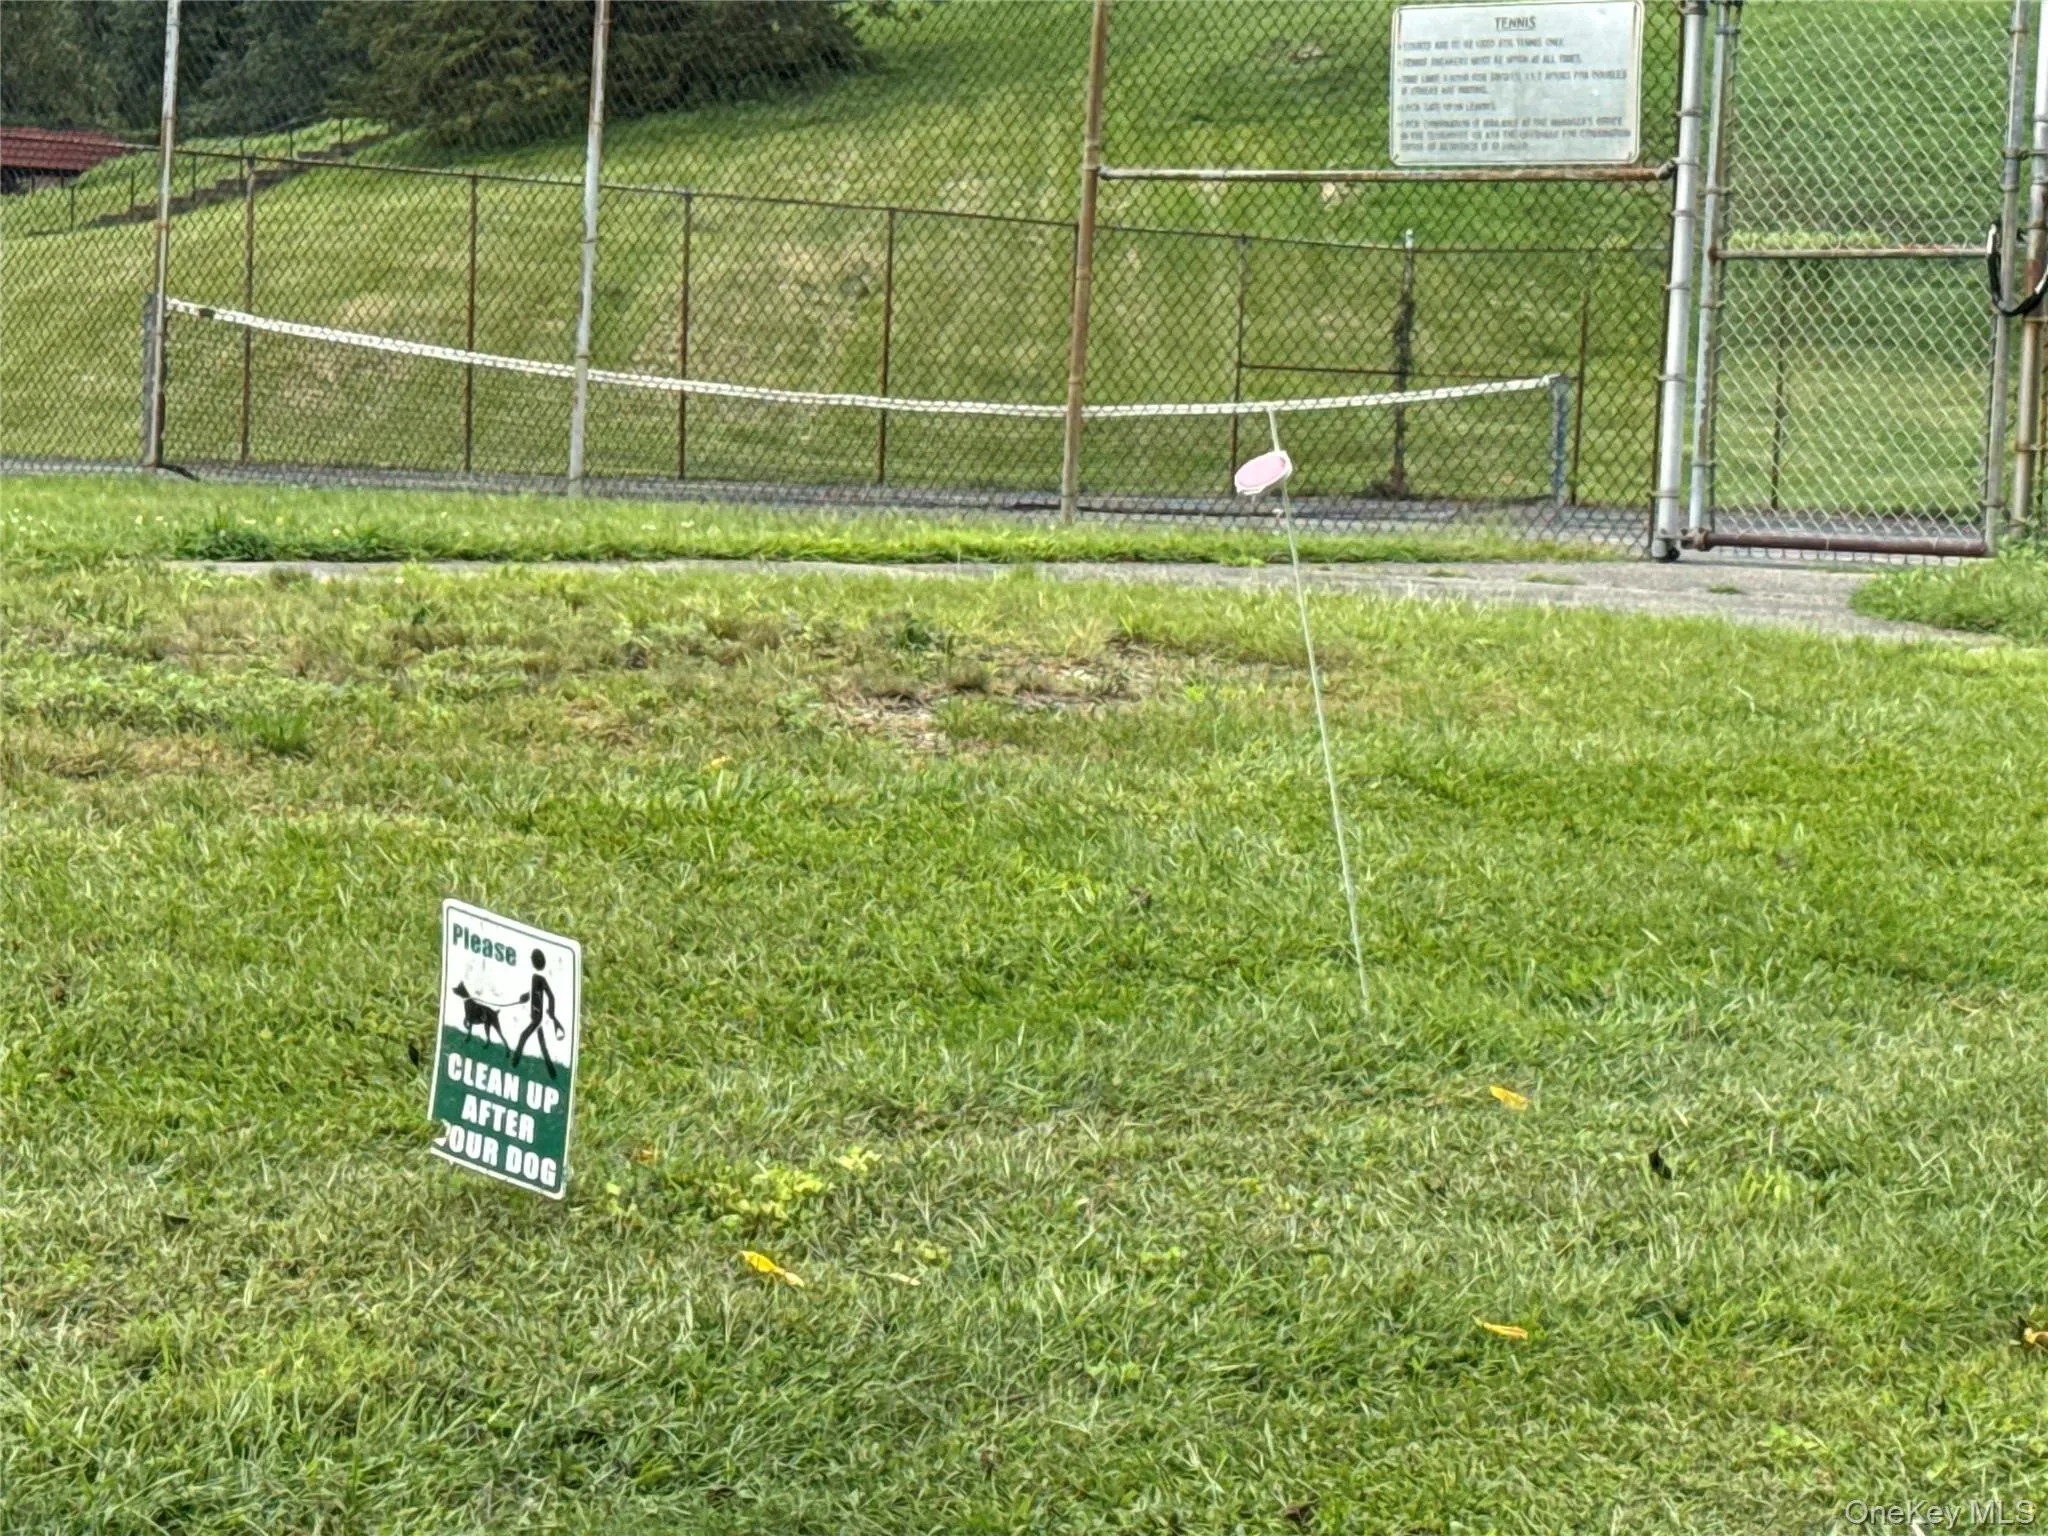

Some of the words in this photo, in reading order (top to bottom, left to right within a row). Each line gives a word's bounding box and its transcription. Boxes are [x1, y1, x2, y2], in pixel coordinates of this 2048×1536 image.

[1495, 16, 1537, 29] TENNIS
[453, 923, 517, 966] Please
[447, 1052, 520, 1102] CLEAN
[526, 1080, 559, 1114] UP
[461, 1094, 535, 1144] AFTER
[505, 1144, 557, 1187] DOG
